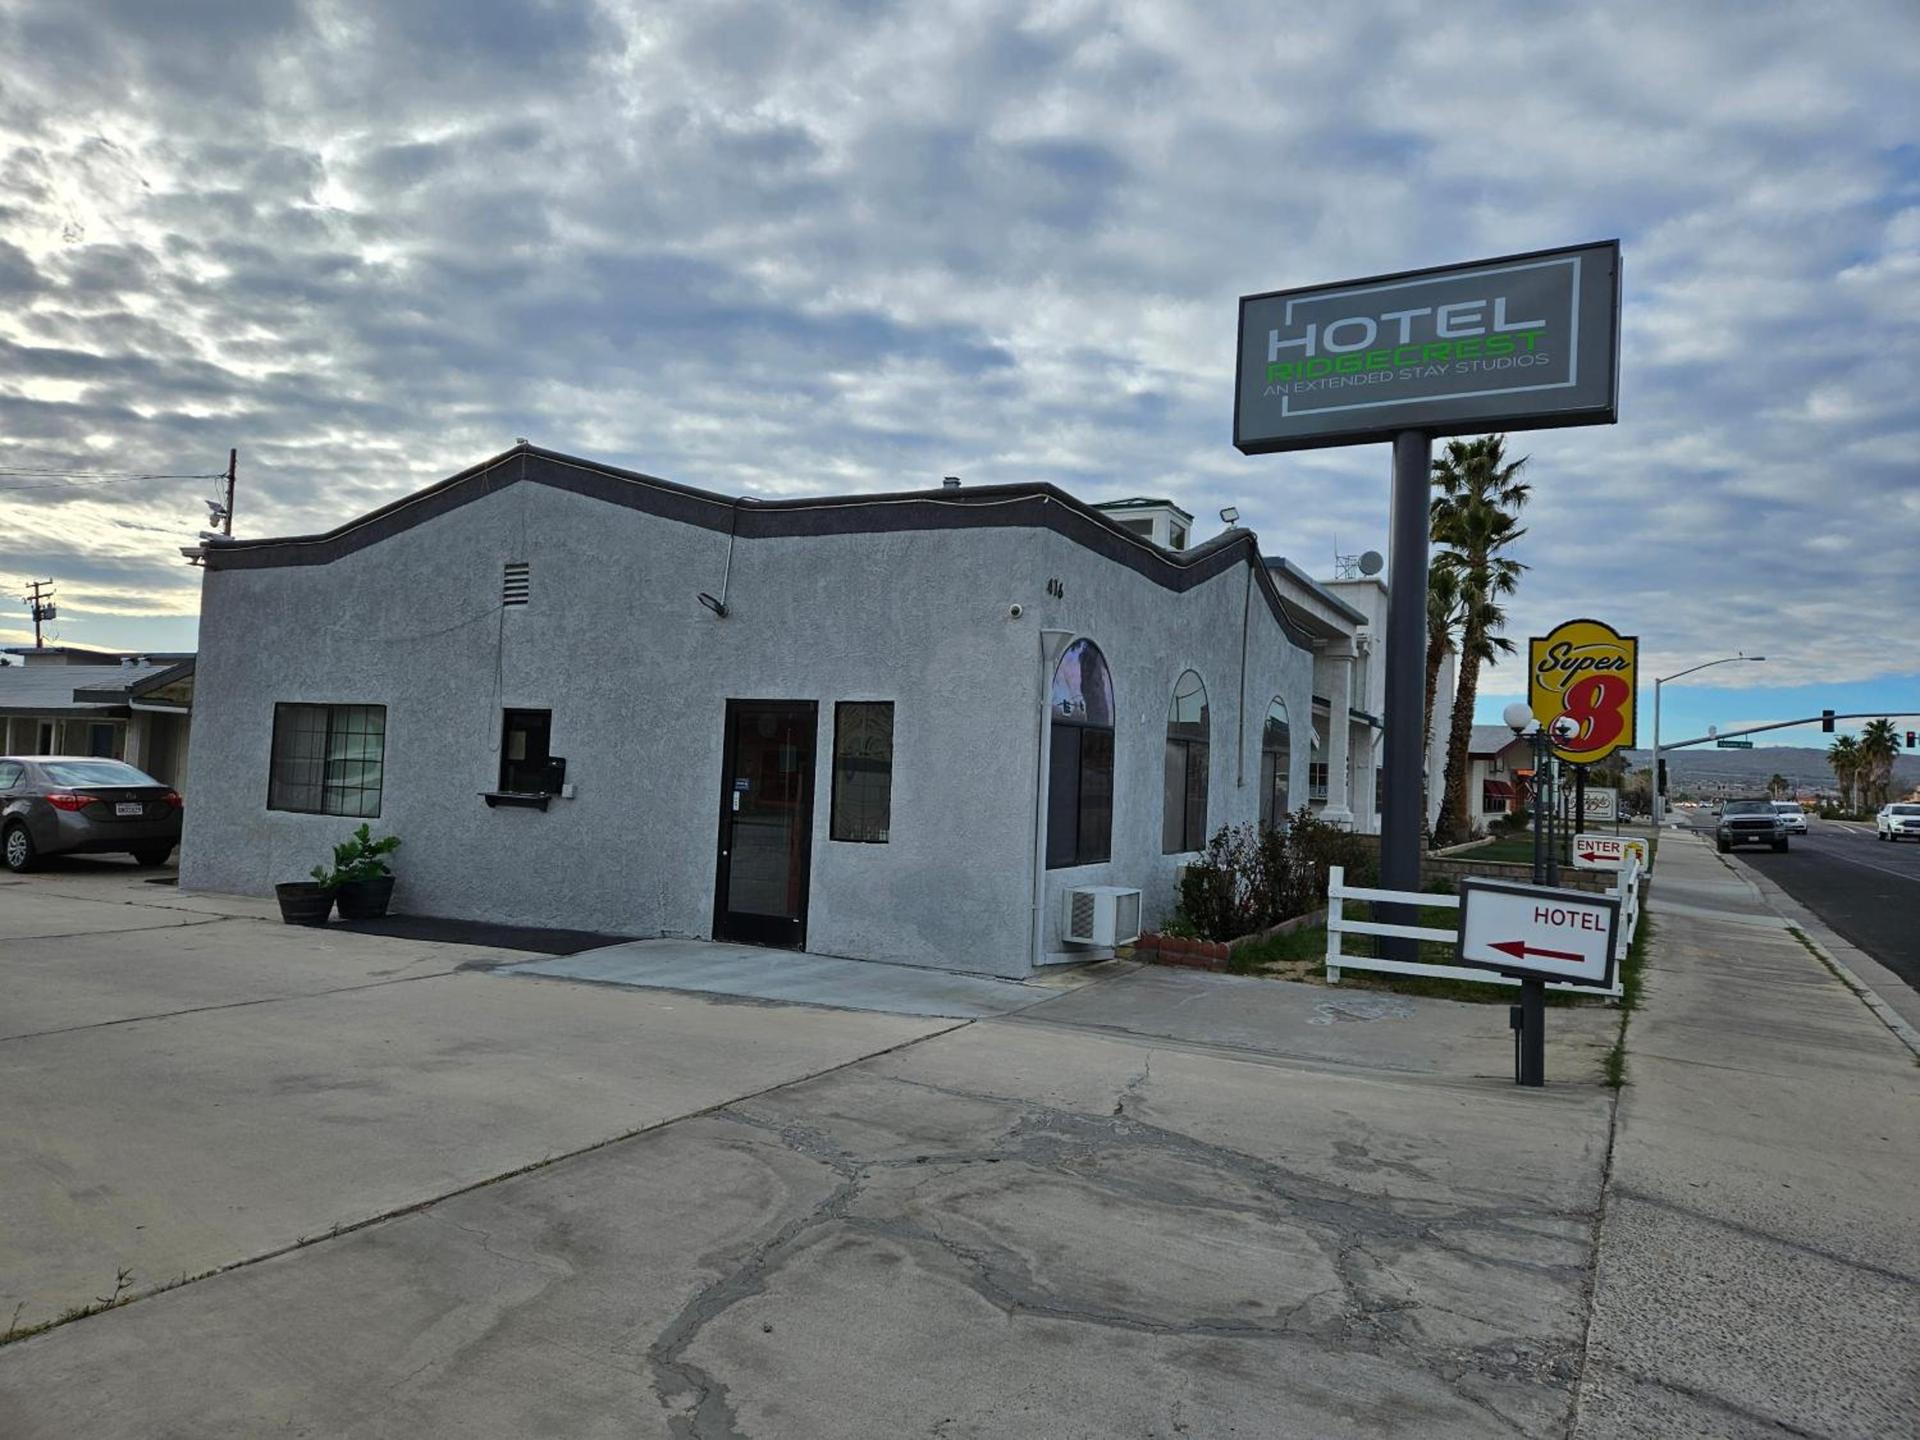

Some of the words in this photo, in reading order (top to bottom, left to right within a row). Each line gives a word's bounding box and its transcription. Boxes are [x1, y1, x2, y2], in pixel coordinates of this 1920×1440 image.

[1268, 297, 1546, 361] HOTEL
[1264, 383, 1289, 396] AN
[1294, 370, 1394, 393] EXTENDED
[1399, 364, 1449, 380] STAY
[1455, 353, 1550, 374] STUDIOS
[1266, 330, 1547, 384] RIDGECREST
[1538, 641, 1631, 687] Super
[1550, 674, 1630, 752] 8
[1577, 840, 1621, 853] ENTER
[1534, 906, 1607, 932] HOTEL
